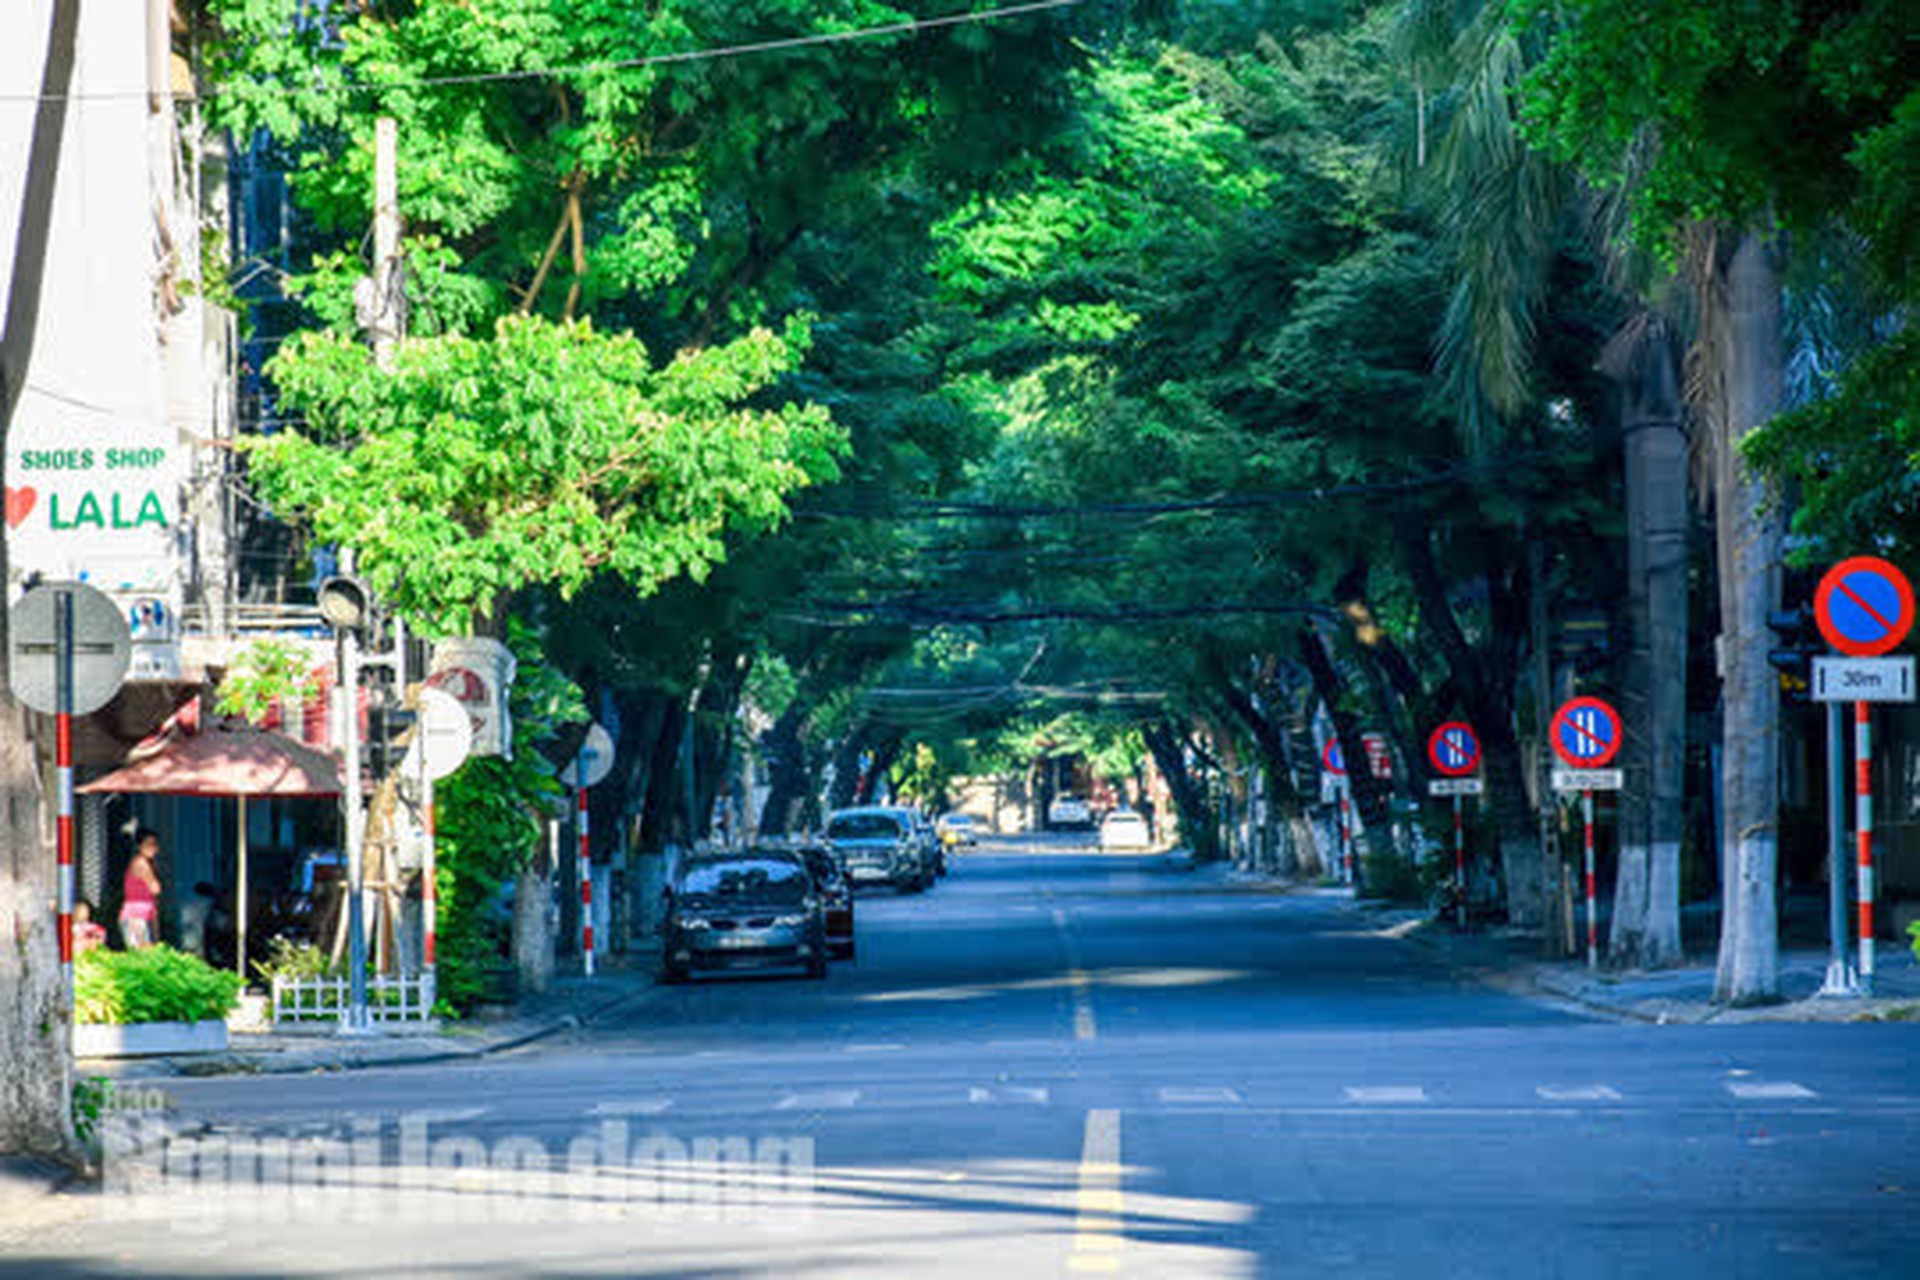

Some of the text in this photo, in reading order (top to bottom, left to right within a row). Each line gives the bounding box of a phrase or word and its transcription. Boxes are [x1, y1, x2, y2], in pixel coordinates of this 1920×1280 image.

[20, 447, 166, 471] SHOES SHOP
[50, 489, 169, 530] LALA
